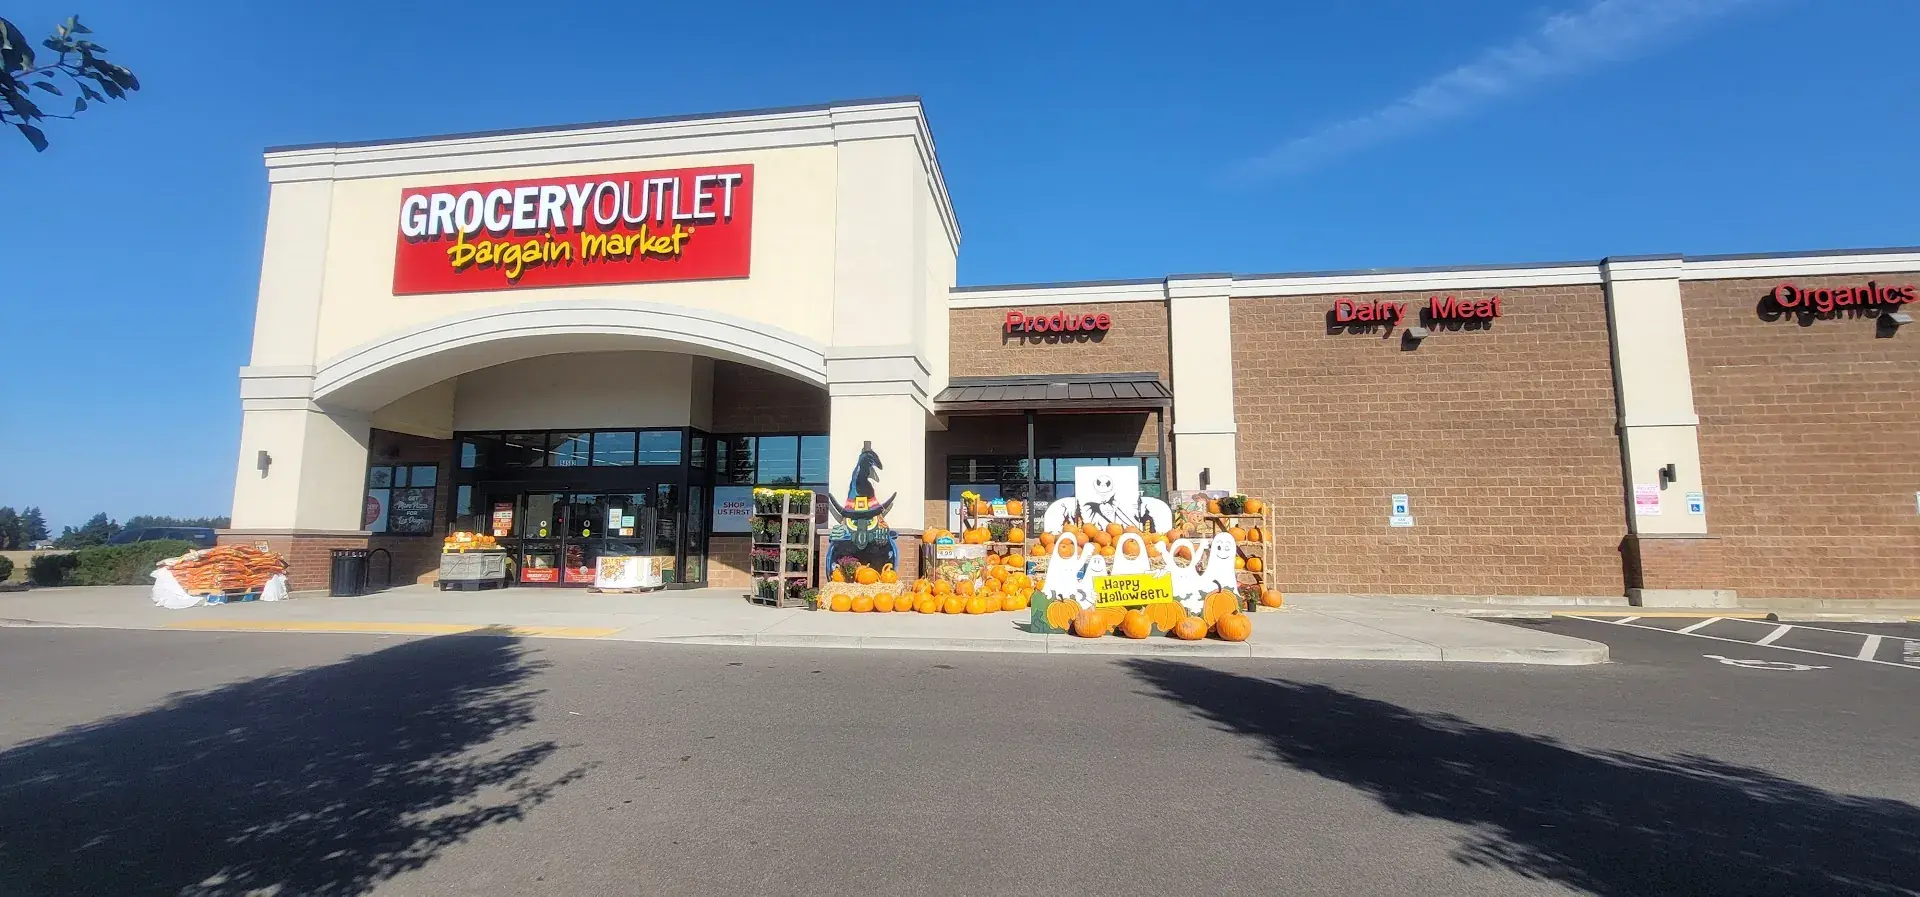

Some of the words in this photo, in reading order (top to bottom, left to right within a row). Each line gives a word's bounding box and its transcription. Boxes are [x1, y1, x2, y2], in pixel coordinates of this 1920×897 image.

[446, 225, 570, 279] bargain
[580, 223, 692, 259] market
[1774, 280, 1920, 312] Organics
[1006, 310, 1112, 333] Produce
[1335, 297, 1407, 326] Dairy
[1430, 295, 1501, 319] Meat
[1097, 588, 1169, 604] Halloween
[1102, 579, 1140, 592] Happy
